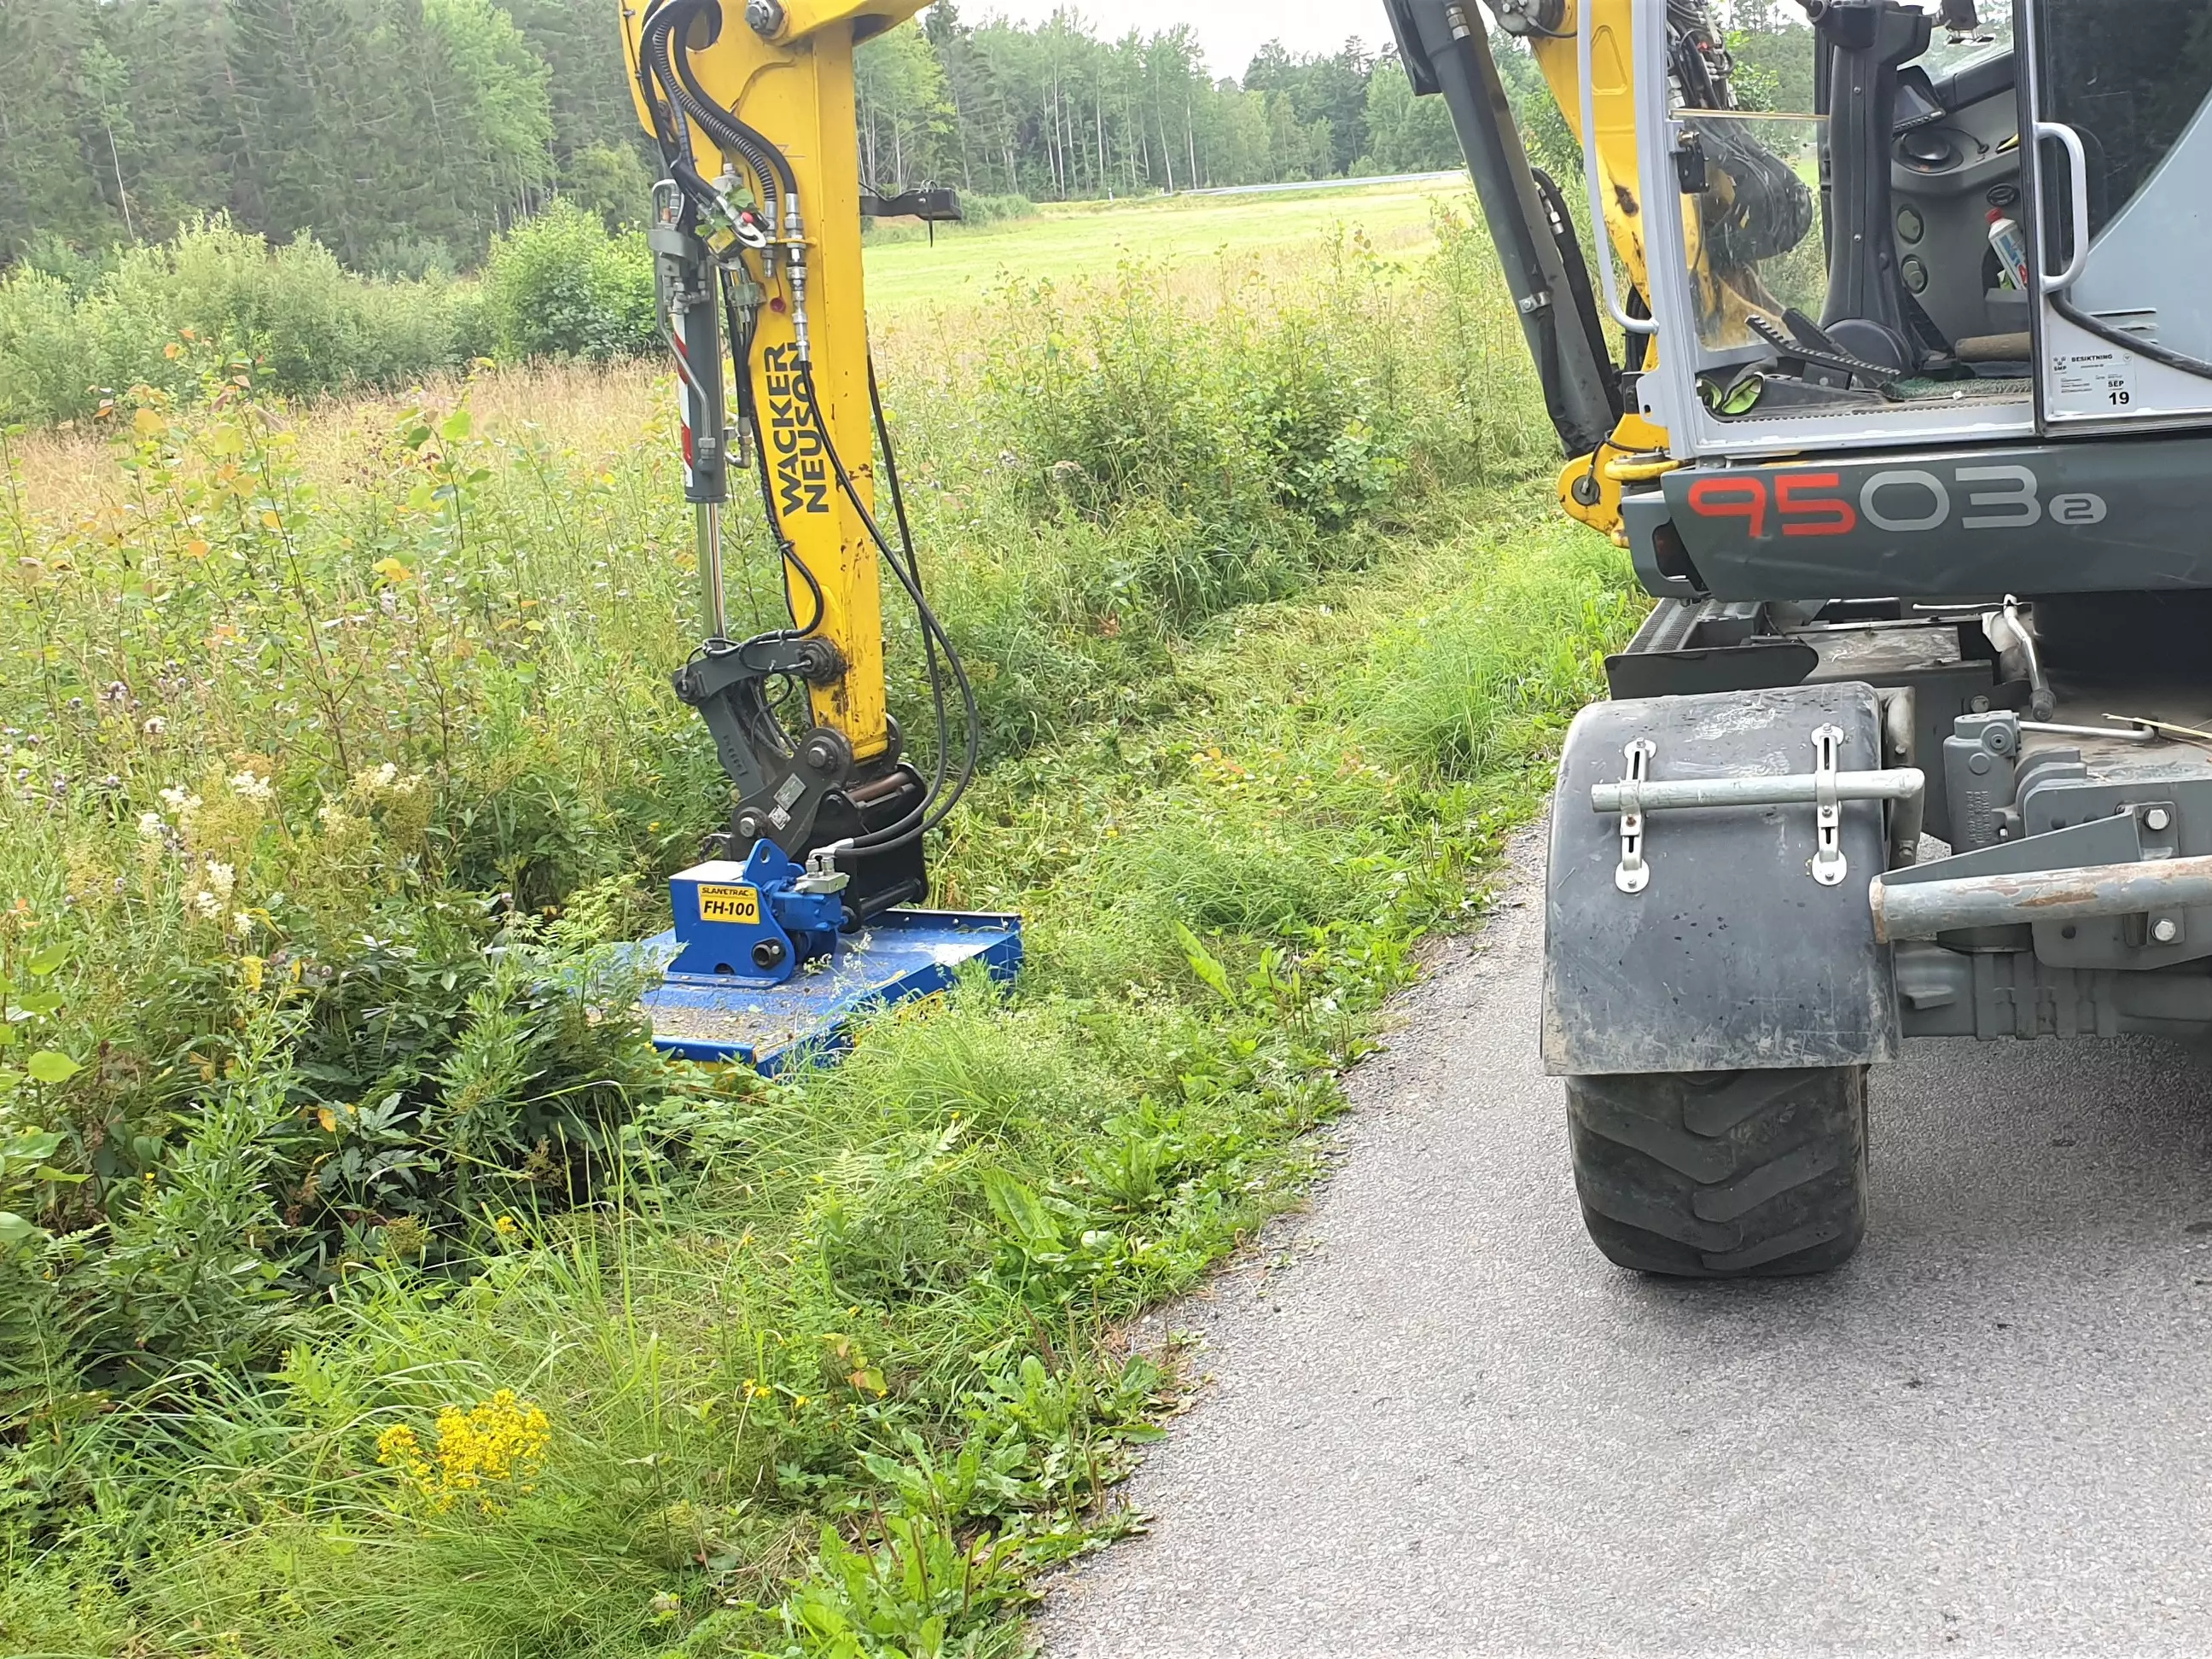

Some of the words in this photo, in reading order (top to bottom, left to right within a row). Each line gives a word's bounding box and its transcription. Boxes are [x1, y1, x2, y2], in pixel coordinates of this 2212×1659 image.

[764, 342, 804, 517] WACKER
[787, 341, 830, 513] NEUSON
[2109, 391, 2130, 405] 19
[703, 900, 755, 917] FH-100
